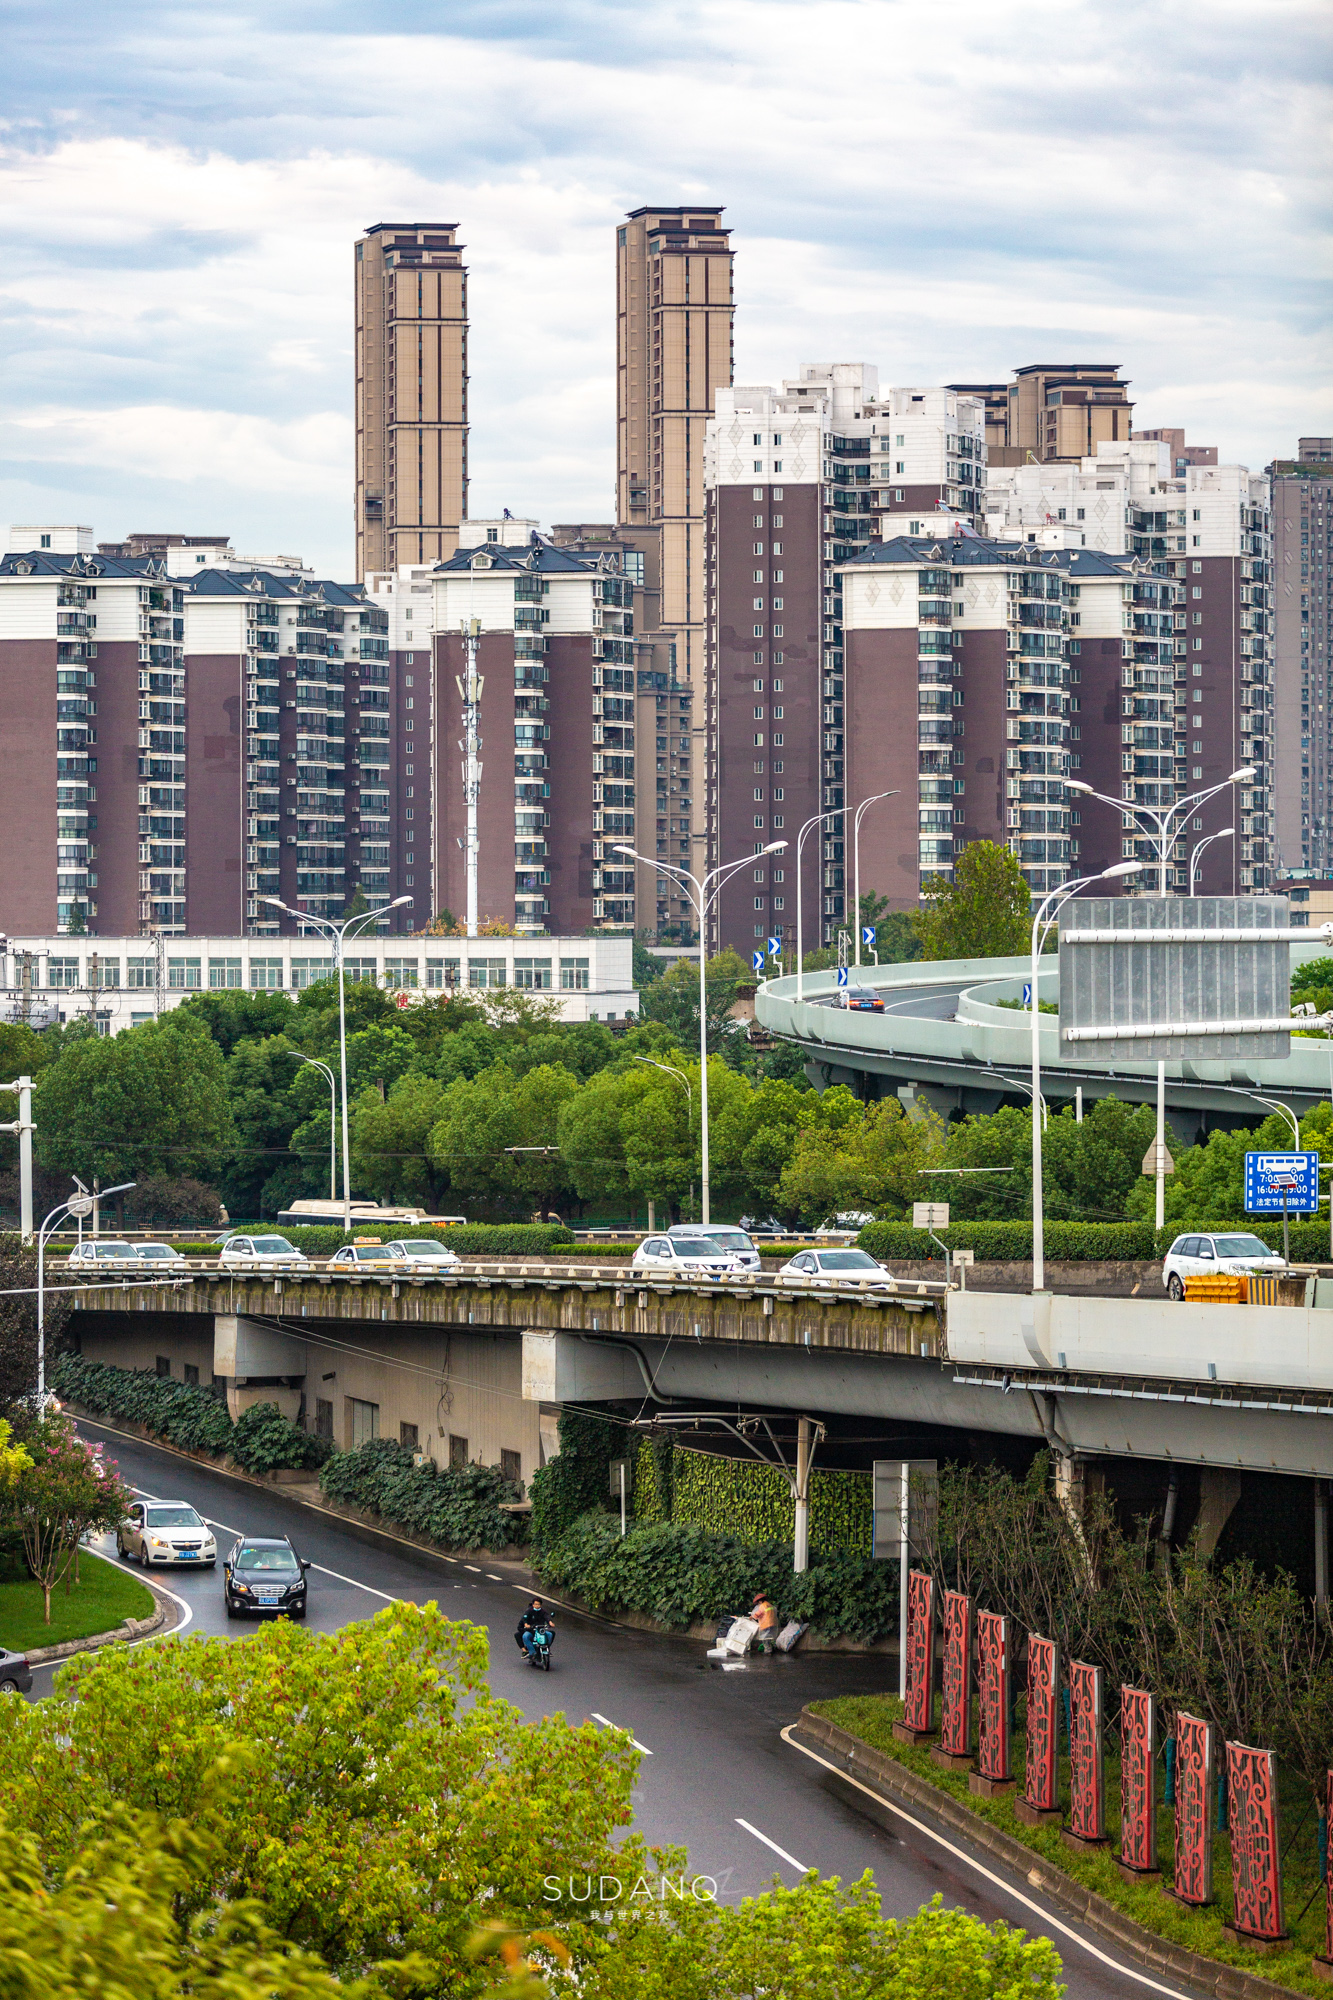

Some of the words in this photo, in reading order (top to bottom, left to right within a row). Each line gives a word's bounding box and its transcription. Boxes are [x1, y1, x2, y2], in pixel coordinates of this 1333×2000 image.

[1256, 1197, 1307, 1207] 法定节假日除外
